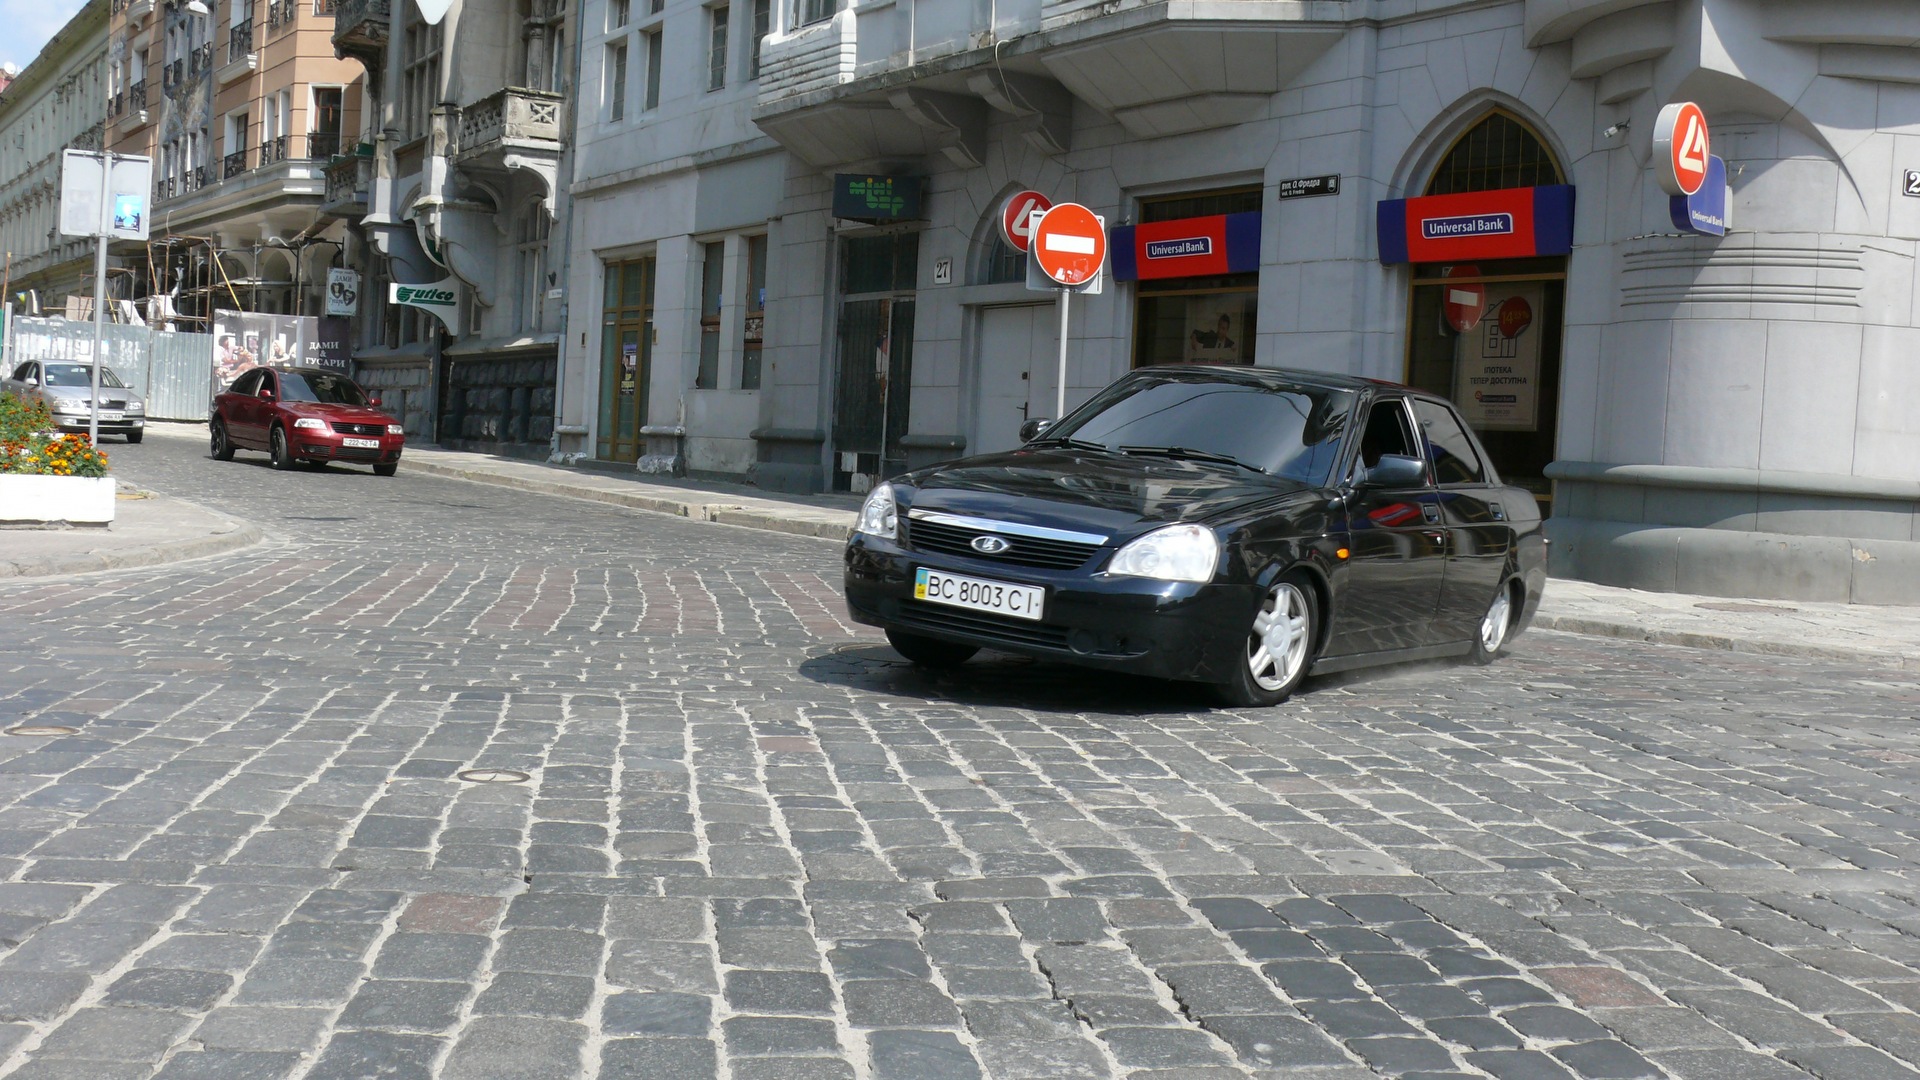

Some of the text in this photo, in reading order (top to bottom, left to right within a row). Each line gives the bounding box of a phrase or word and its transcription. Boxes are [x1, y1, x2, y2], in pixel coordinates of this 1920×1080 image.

[1429, 218, 1504, 234] Universal Bank
[1151, 241, 1204, 255] Universal Bank
[936, 261, 948, 278] 27
[309, 341, 339, 350] ДАМИ
[305, 357, 346, 368] ГУСАРИ
[1489, 377, 1527, 386] ДОСТУПНА
[928, 575, 1033, 614] BC 8003 CI
